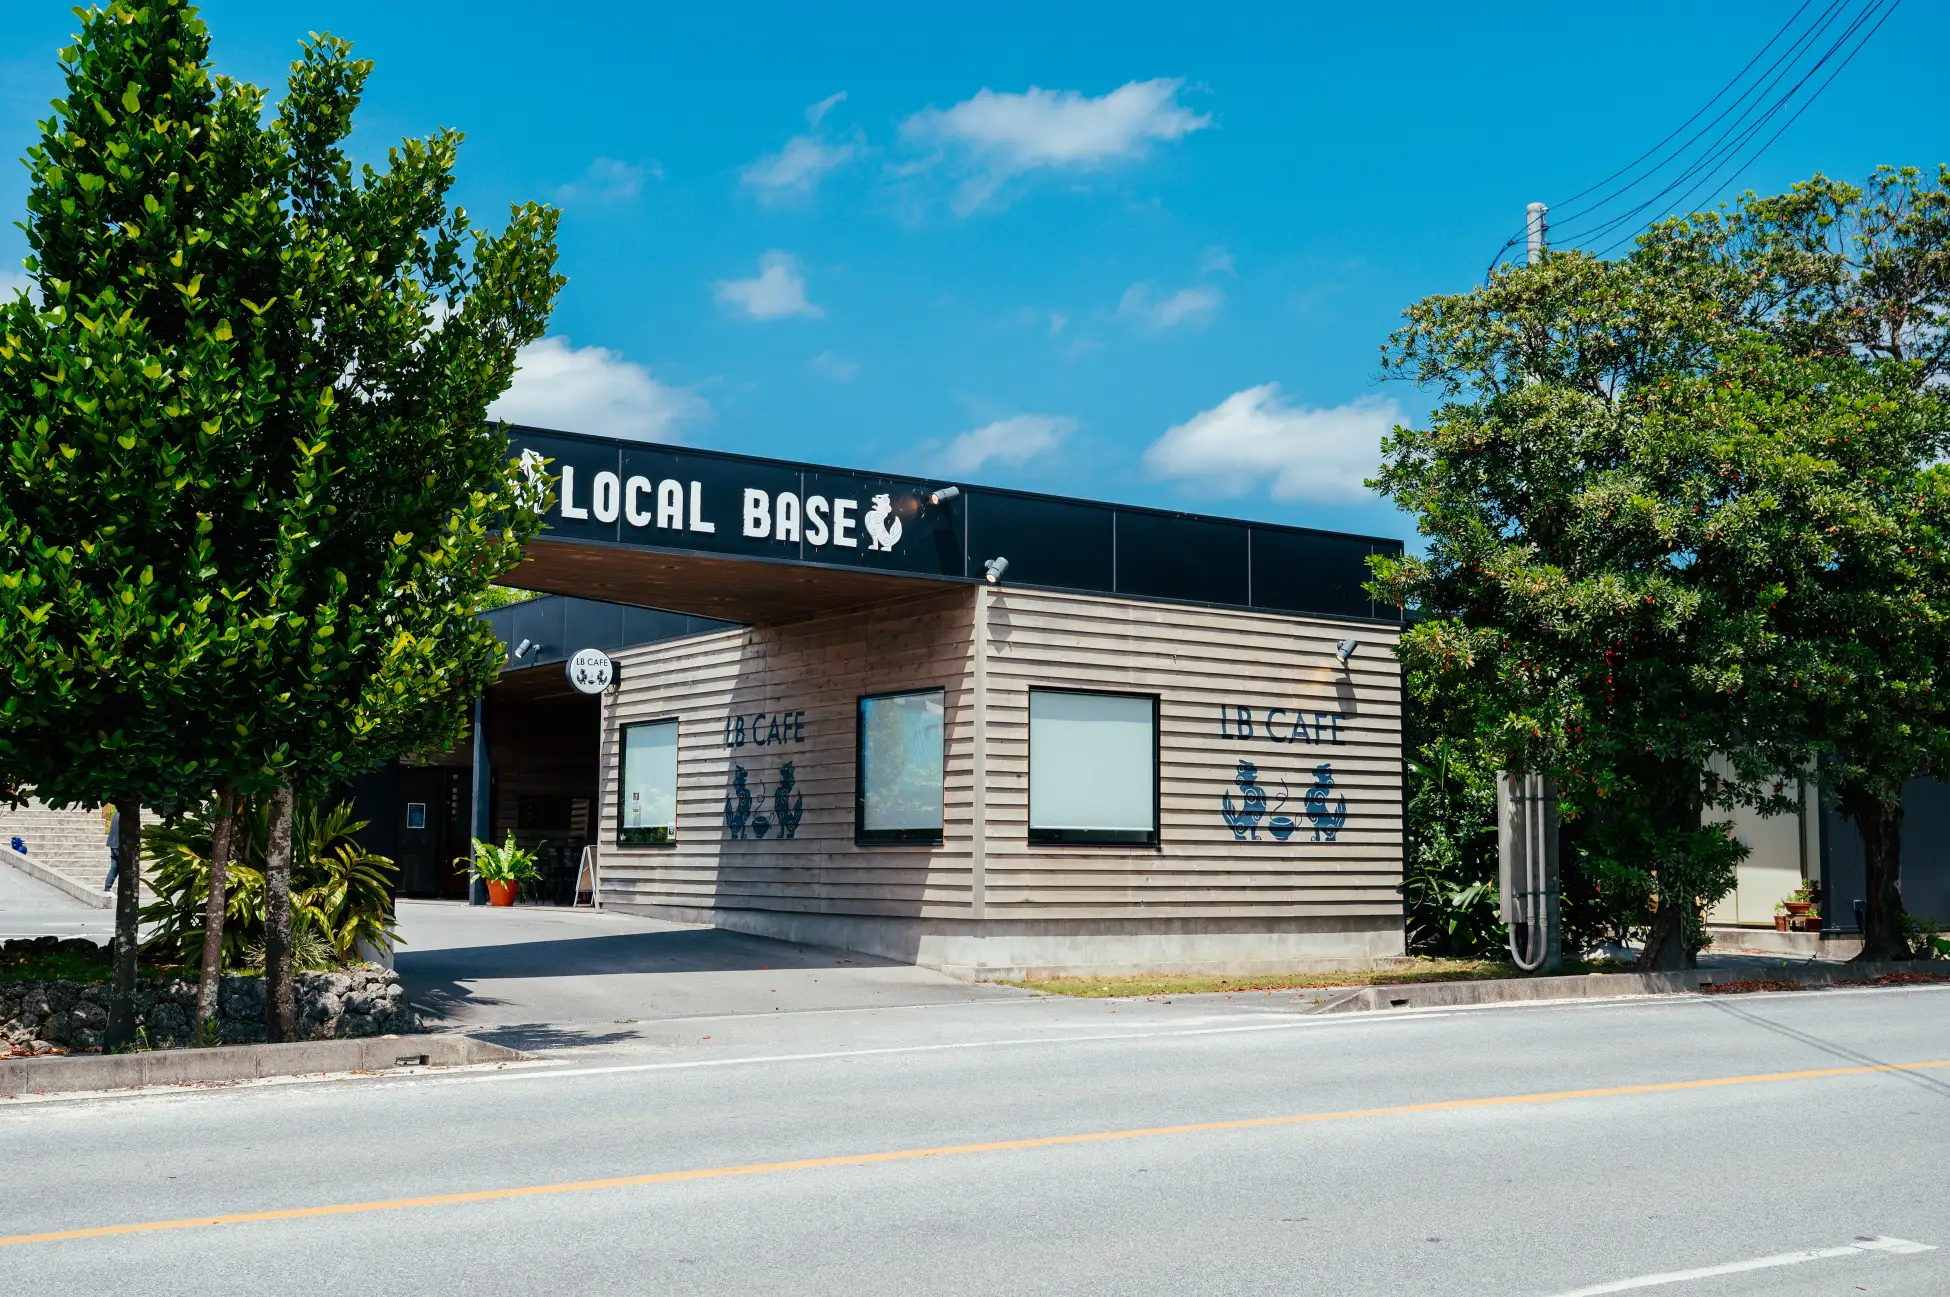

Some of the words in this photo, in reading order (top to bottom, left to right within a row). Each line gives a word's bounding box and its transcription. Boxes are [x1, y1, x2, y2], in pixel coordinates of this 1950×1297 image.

[561, 465, 715, 533] LOCAL
[743, 488, 858, 547] BASE
[576, 657, 585, 666] LB
[587, 658, 608, 667] CAFE
[727, 715, 745, 748] LB
[753, 711, 805, 746] CAFE
[1221, 704, 1254, 740] LB
[1266, 708, 1346, 746] CAFE
